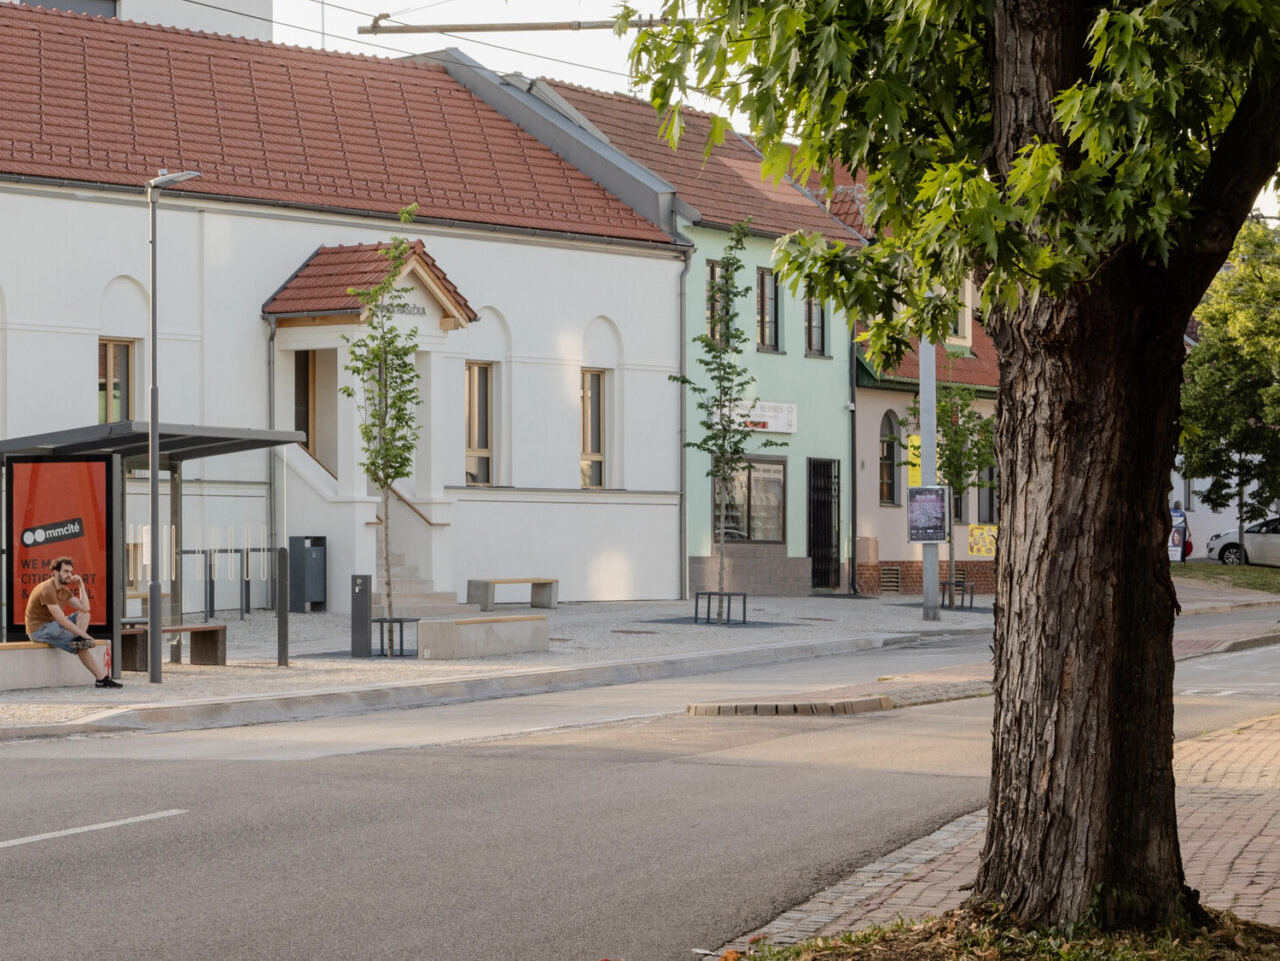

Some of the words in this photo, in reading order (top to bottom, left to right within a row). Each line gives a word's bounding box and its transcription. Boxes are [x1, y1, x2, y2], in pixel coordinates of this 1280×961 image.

[46, 522, 80, 538] mmcité
[21, 559, 38, 569] WE
[21, 573, 51, 584] CITIE
